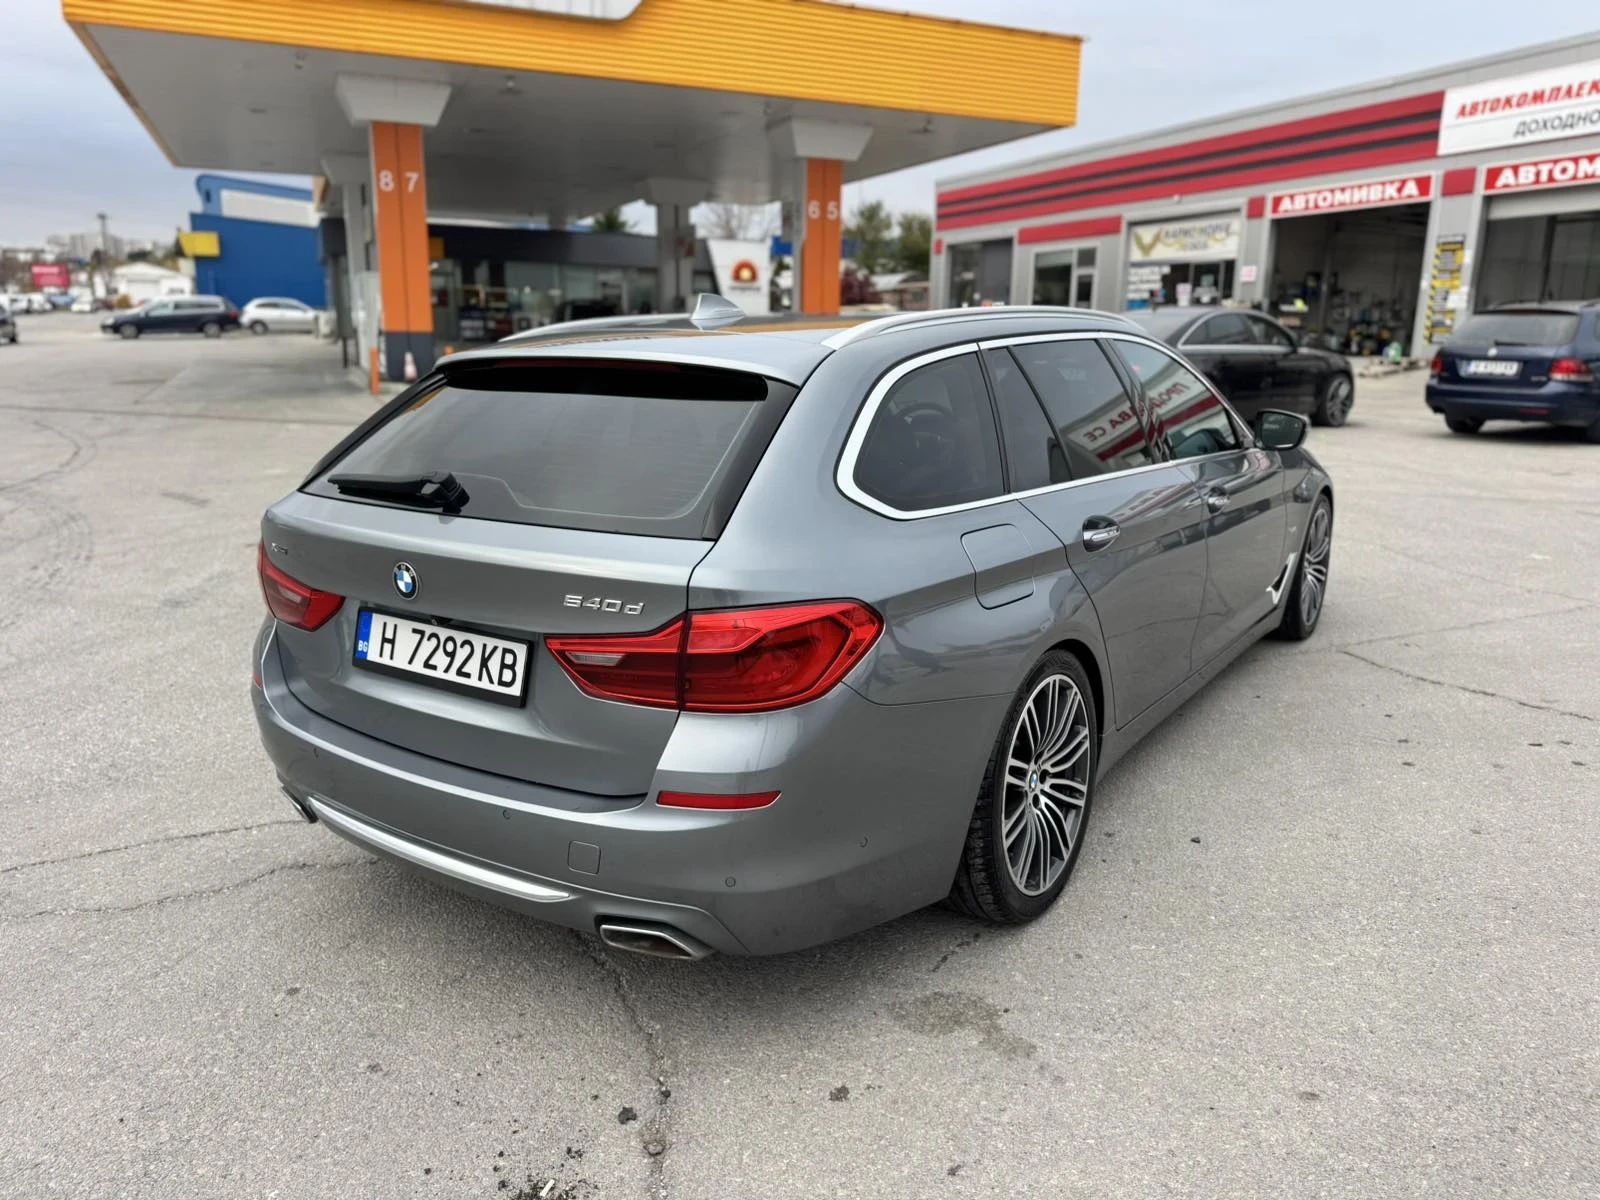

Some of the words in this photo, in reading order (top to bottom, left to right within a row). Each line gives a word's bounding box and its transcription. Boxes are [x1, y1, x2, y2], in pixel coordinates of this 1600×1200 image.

[379, 170, 394, 192] 8
[404, 172, 419, 192] 7
[1494, 156, 1600, 187] АВТОМ
[1278, 178, 1419, 212] АВТОМИВКА
[358, 640, 368, 652] BG
